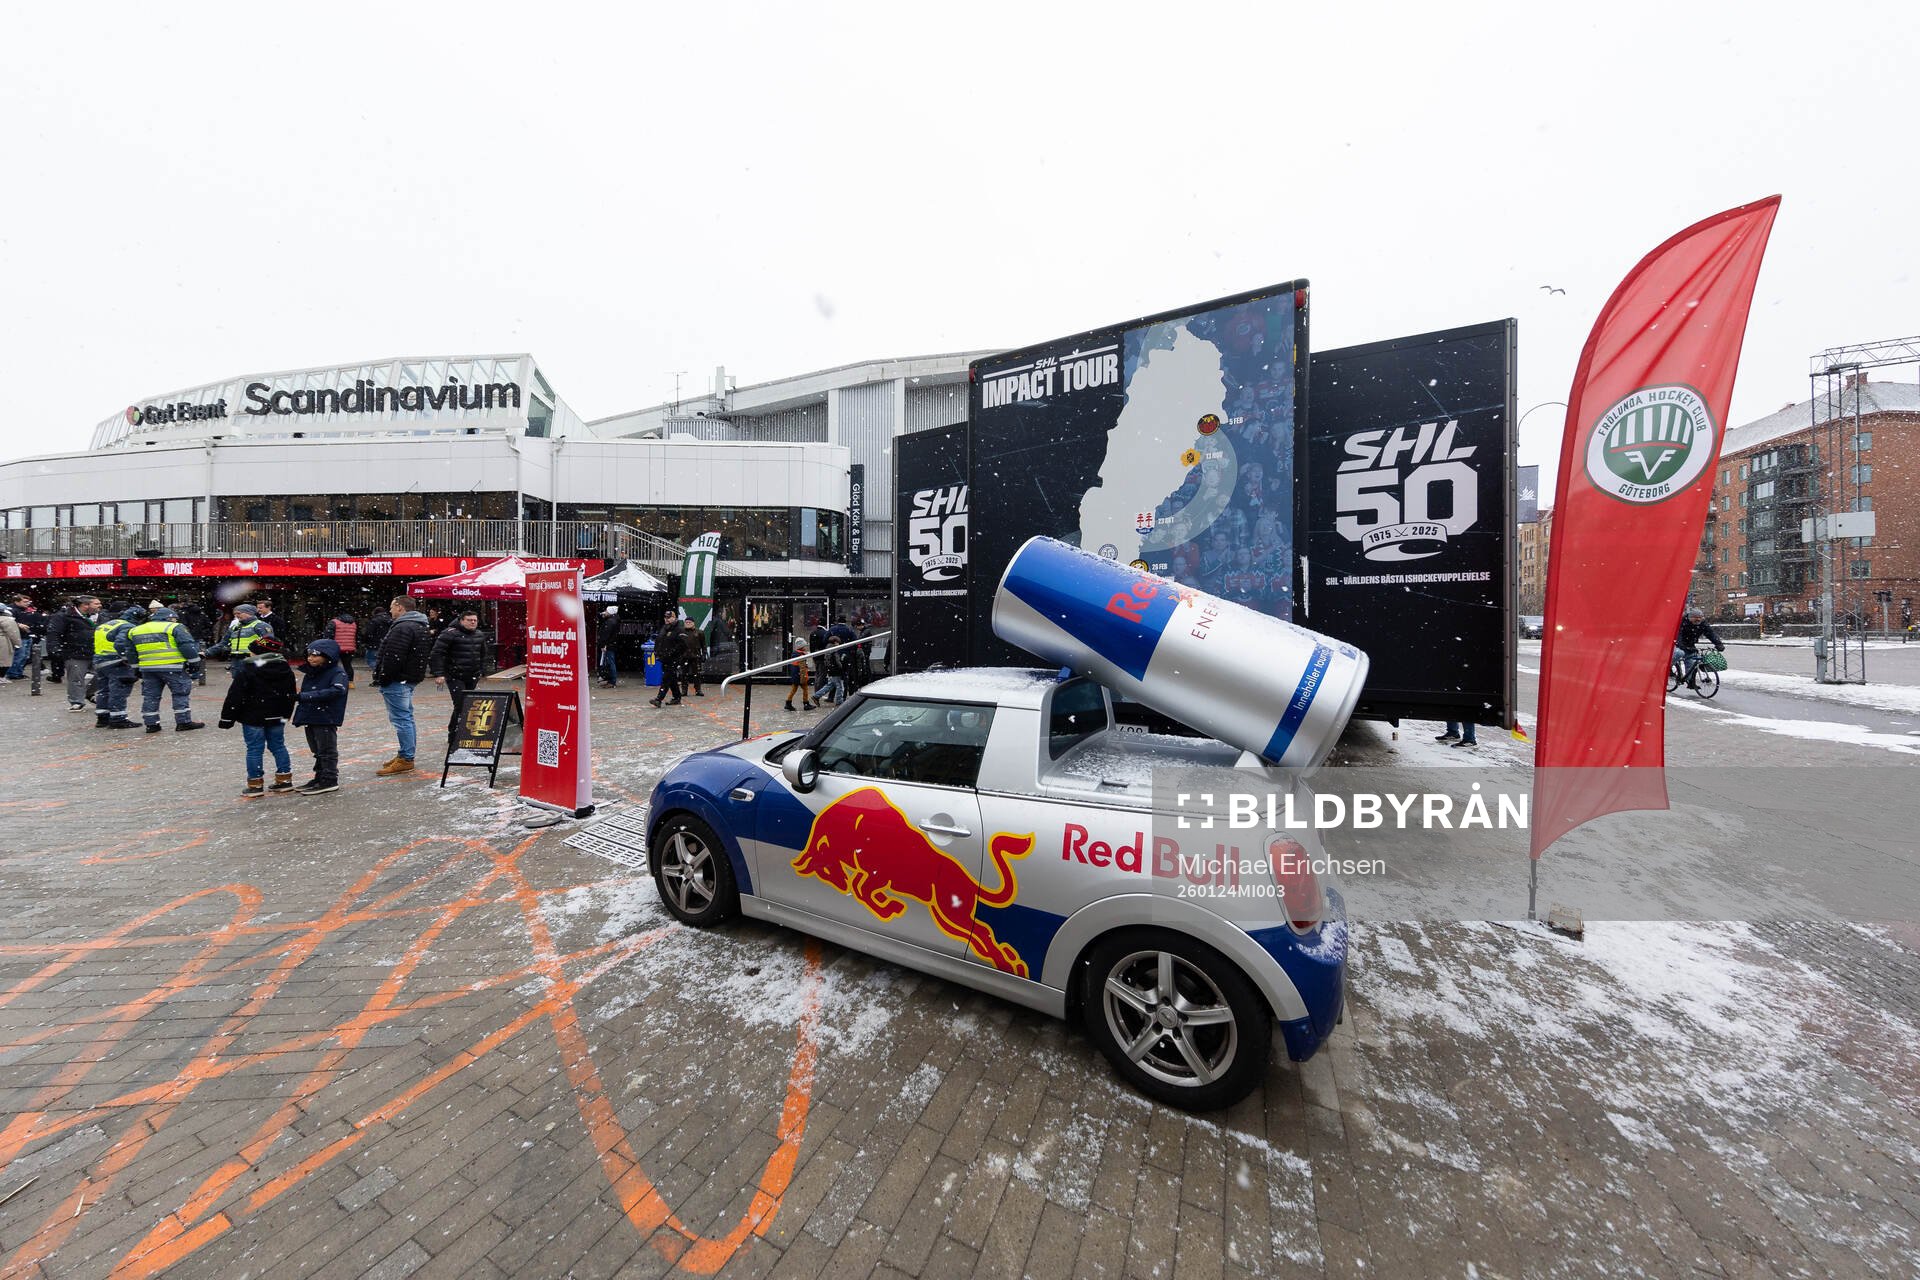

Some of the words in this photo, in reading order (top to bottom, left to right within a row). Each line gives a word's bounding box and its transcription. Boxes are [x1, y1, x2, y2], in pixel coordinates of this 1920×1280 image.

[1035, 357, 1058, 370] SHL
[982, 367, 1057, 409] IMPACT
[1061, 353, 1118, 393] TOUR
[244, 376, 520, 415] Scandinavium
[143, 404, 176, 425] Got
[177, 399, 227, 421] Event
[1598, 396, 1643, 436] FRÖLUNDA
[1649, 390, 1695, 406] HOCKEY
[1693, 406, 1706, 432] CLUB
[1337, 420, 1478, 472] SHL
[852, 483, 860, 506] Glöd
[1619, 483, 1670, 498] GÖTEBORG
[910, 485, 968, 517] SHL
[1336, 461, 1478, 541] 50
[852, 509, 860, 527] Kök
[909, 513, 968, 567] 50
[1369, 530, 1391, 543] 1975
[1412, 526, 1438, 536] 2025
[852, 538, 860, 554] Bar
[164, 562, 193, 576] VIP/LOGE
[327, 561, 392, 575] BILJETTER/TICKETS
[1326, 577, 1339, 586] SHL
[1343, 574, 1380, 585] VÄRLDENS
[1381, 573, 1405, 584] BÄSTA
[1405, 572, 1491, 583] ISHOCKEYUPPLEVELSE
[582, 593, 600, 601] MPACT
[538, 627, 564, 640] saknar
[566, 628, 576, 641] du
[532, 645, 541, 654] en
[542, 642, 569, 659] livboj?
[1293, 667, 1321, 711] Innehåller
[1062, 823, 1144, 874] Red
[1152, 835, 1240, 892] Bull
